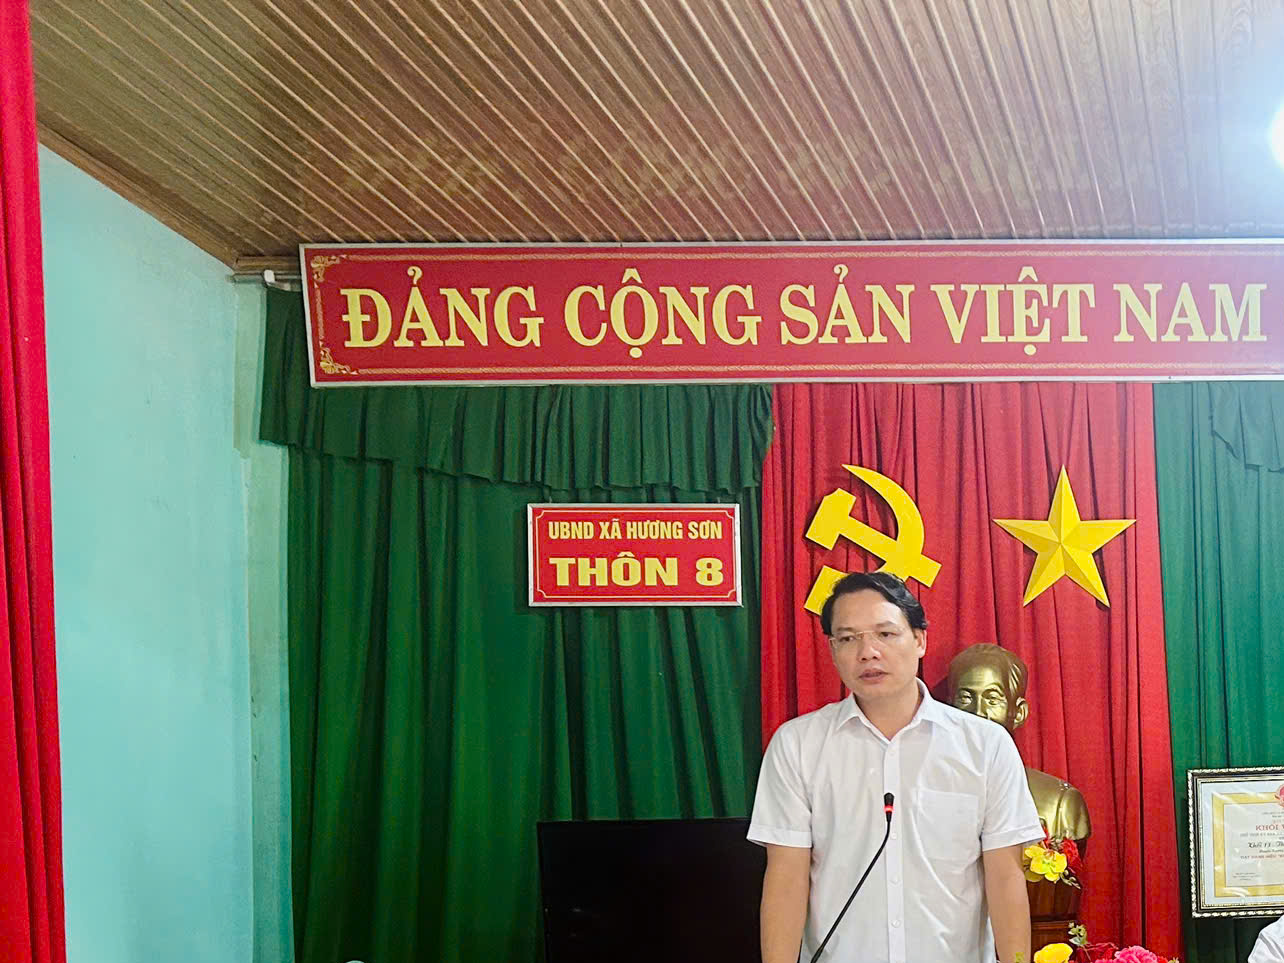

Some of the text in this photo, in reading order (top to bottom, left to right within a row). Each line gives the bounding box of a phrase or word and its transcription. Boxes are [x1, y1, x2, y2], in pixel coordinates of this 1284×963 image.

[341, 266, 544, 348] ĐẢNG
[564, 267, 762, 358] CỘNG
[780, 264, 914, 344] SẢN
[930, 266, 1095, 355] VIỆT
[1113, 282, 1267, 342] NAM
[548, 518, 723, 540] UBND XÃ HƯƠNG SƠN
[549, 551, 724, 586] THÔN 8
